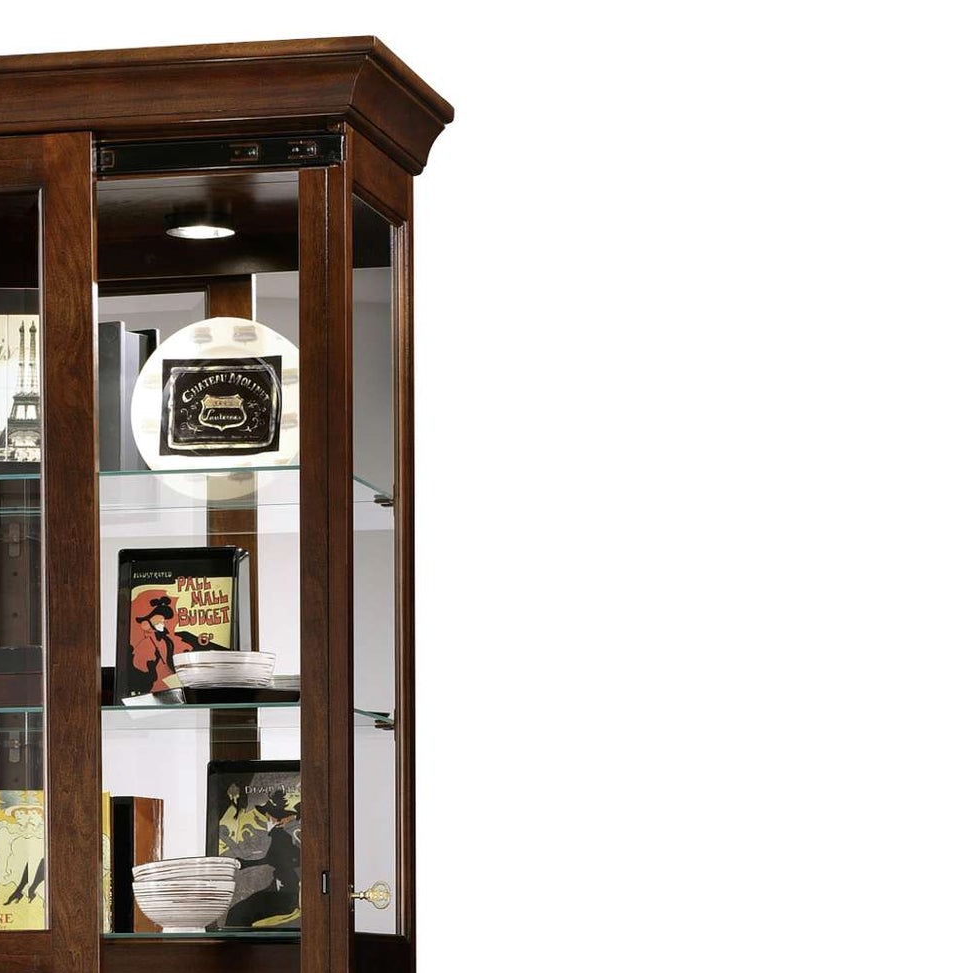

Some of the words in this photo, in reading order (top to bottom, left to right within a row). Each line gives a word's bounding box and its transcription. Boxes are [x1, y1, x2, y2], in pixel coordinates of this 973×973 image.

[182, 374, 226, 403] CHATEAU
[133, 571, 173, 579] ILLUSTRATED
[177, 576, 212, 592] PALL
[191, 590, 229, 607] MALL
[177, 606, 230, 627] BUDGET
